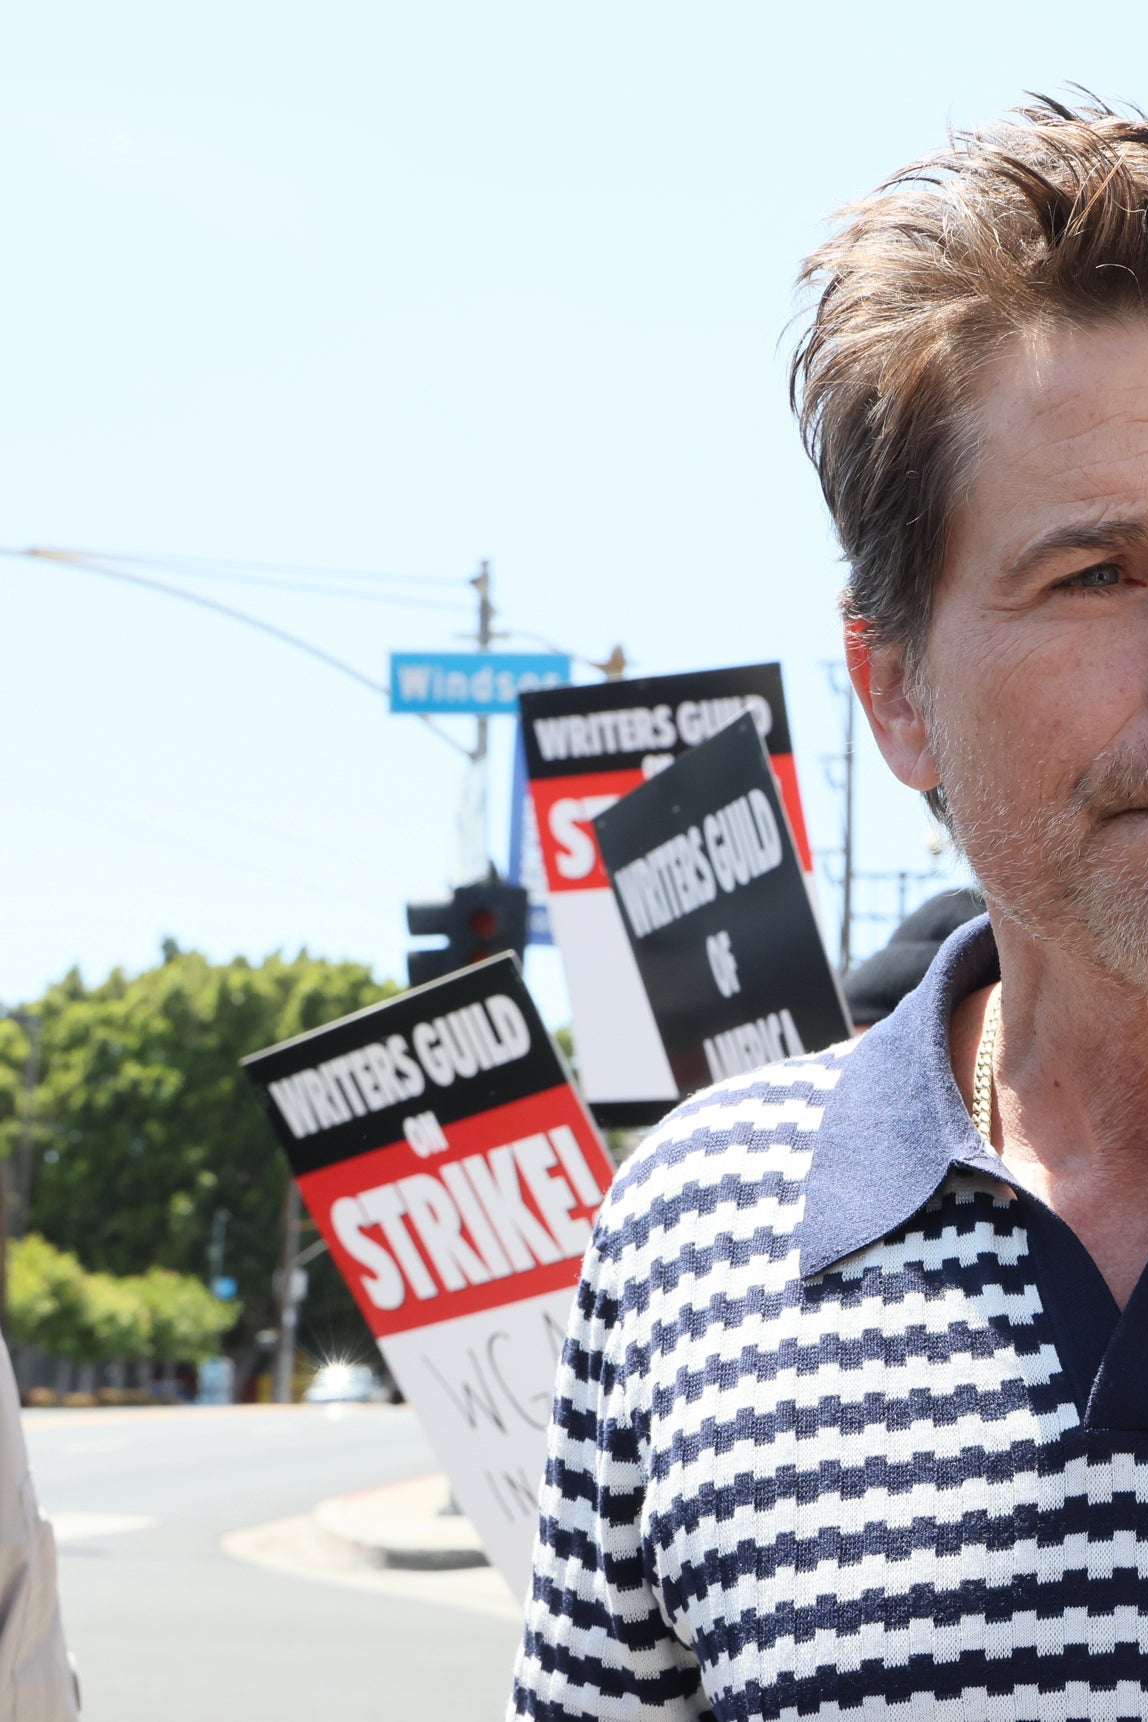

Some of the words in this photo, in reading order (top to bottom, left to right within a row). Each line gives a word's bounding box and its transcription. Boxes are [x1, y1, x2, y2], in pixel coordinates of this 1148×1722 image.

[533, 703, 677, 761] WRITERS
[614, 825, 717, 938] WRITERS
[703, 788, 783, 893] GUILD
[706, 930, 741, 998] OF
[269, 1035, 426, 1139] WRITERS
[412, 994, 532, 1086] GUILD
[703, 1008, 805, 1084] AMERICA
[403, 1110, 449, 1159] ON
[331, 1125, 602, 1311] STRIKE!
